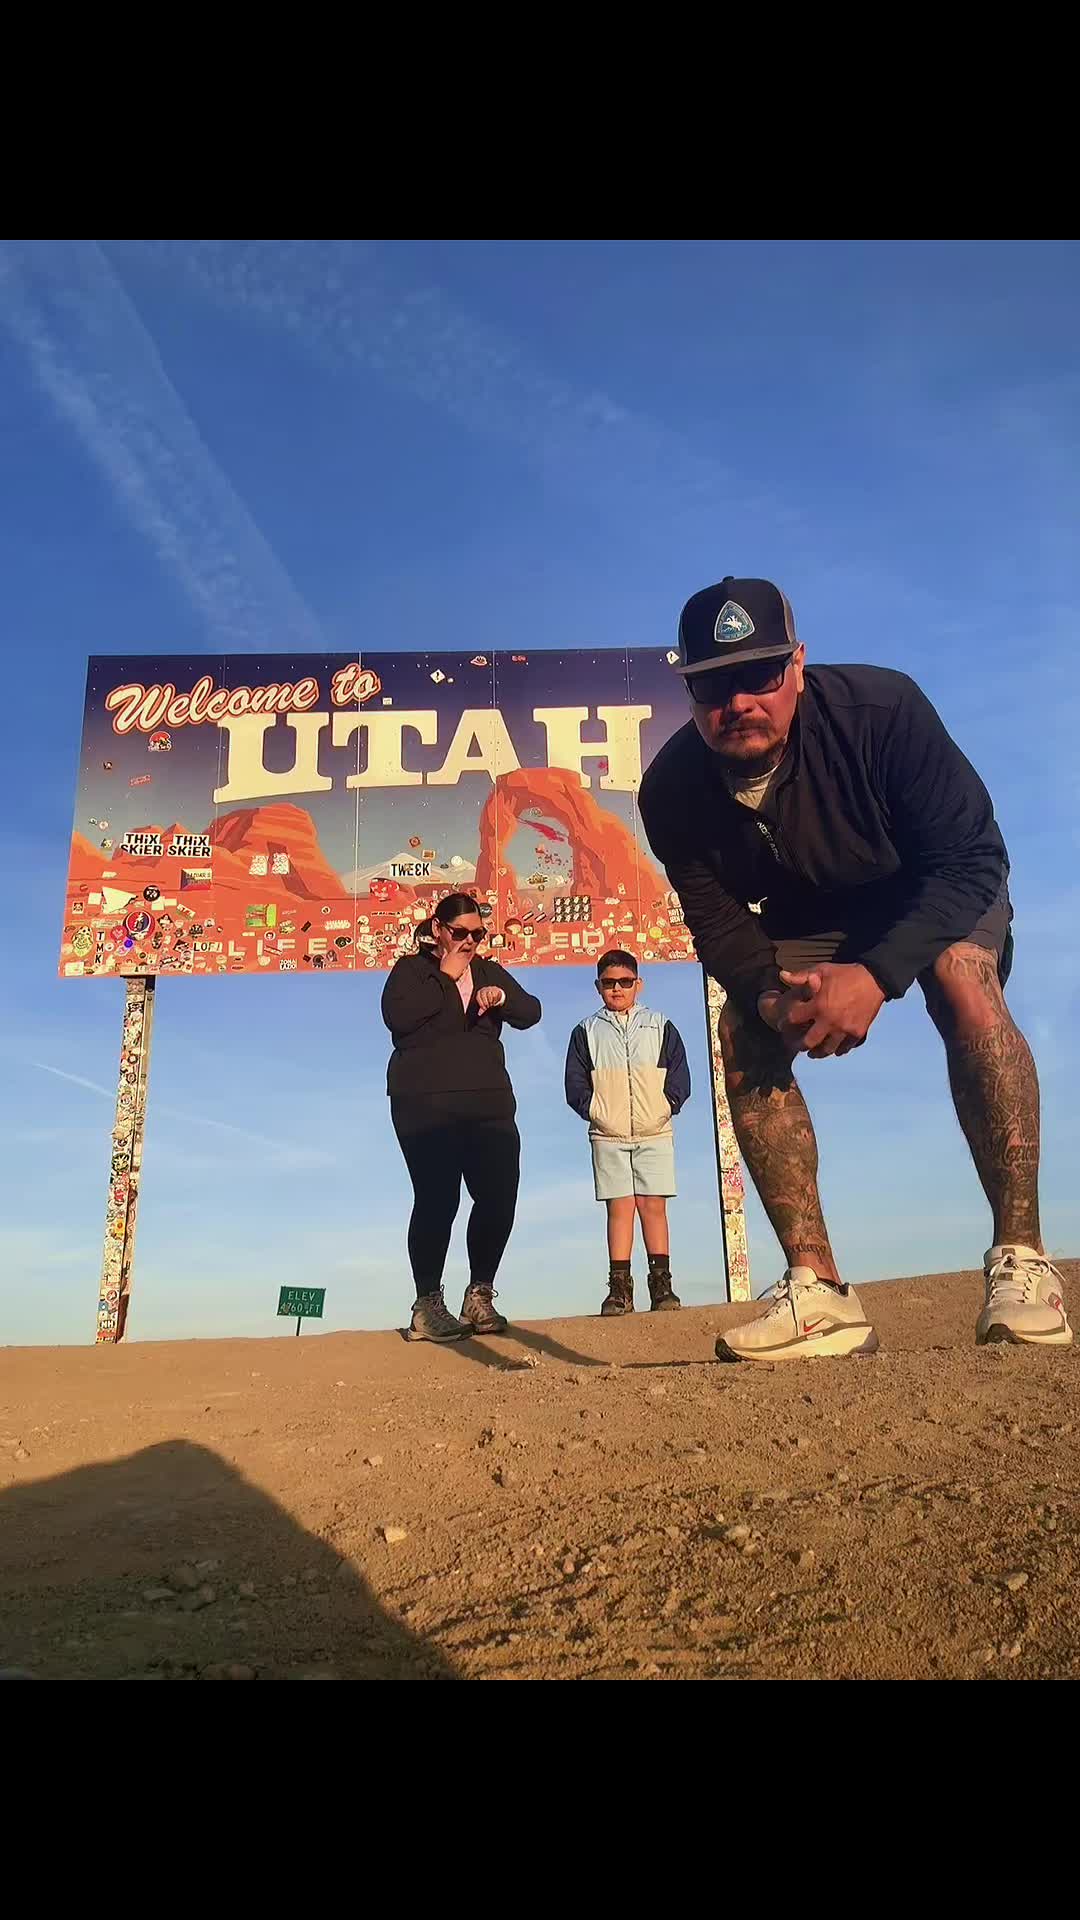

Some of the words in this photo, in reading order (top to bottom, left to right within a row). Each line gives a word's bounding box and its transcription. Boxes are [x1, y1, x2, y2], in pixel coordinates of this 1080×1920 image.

[106, 675, 319, 735] Welcome
[331, 662, 381, 706] to
[213, 704, 653, 804] UTAH
[287, 1290, 316, 1301] ELEV
